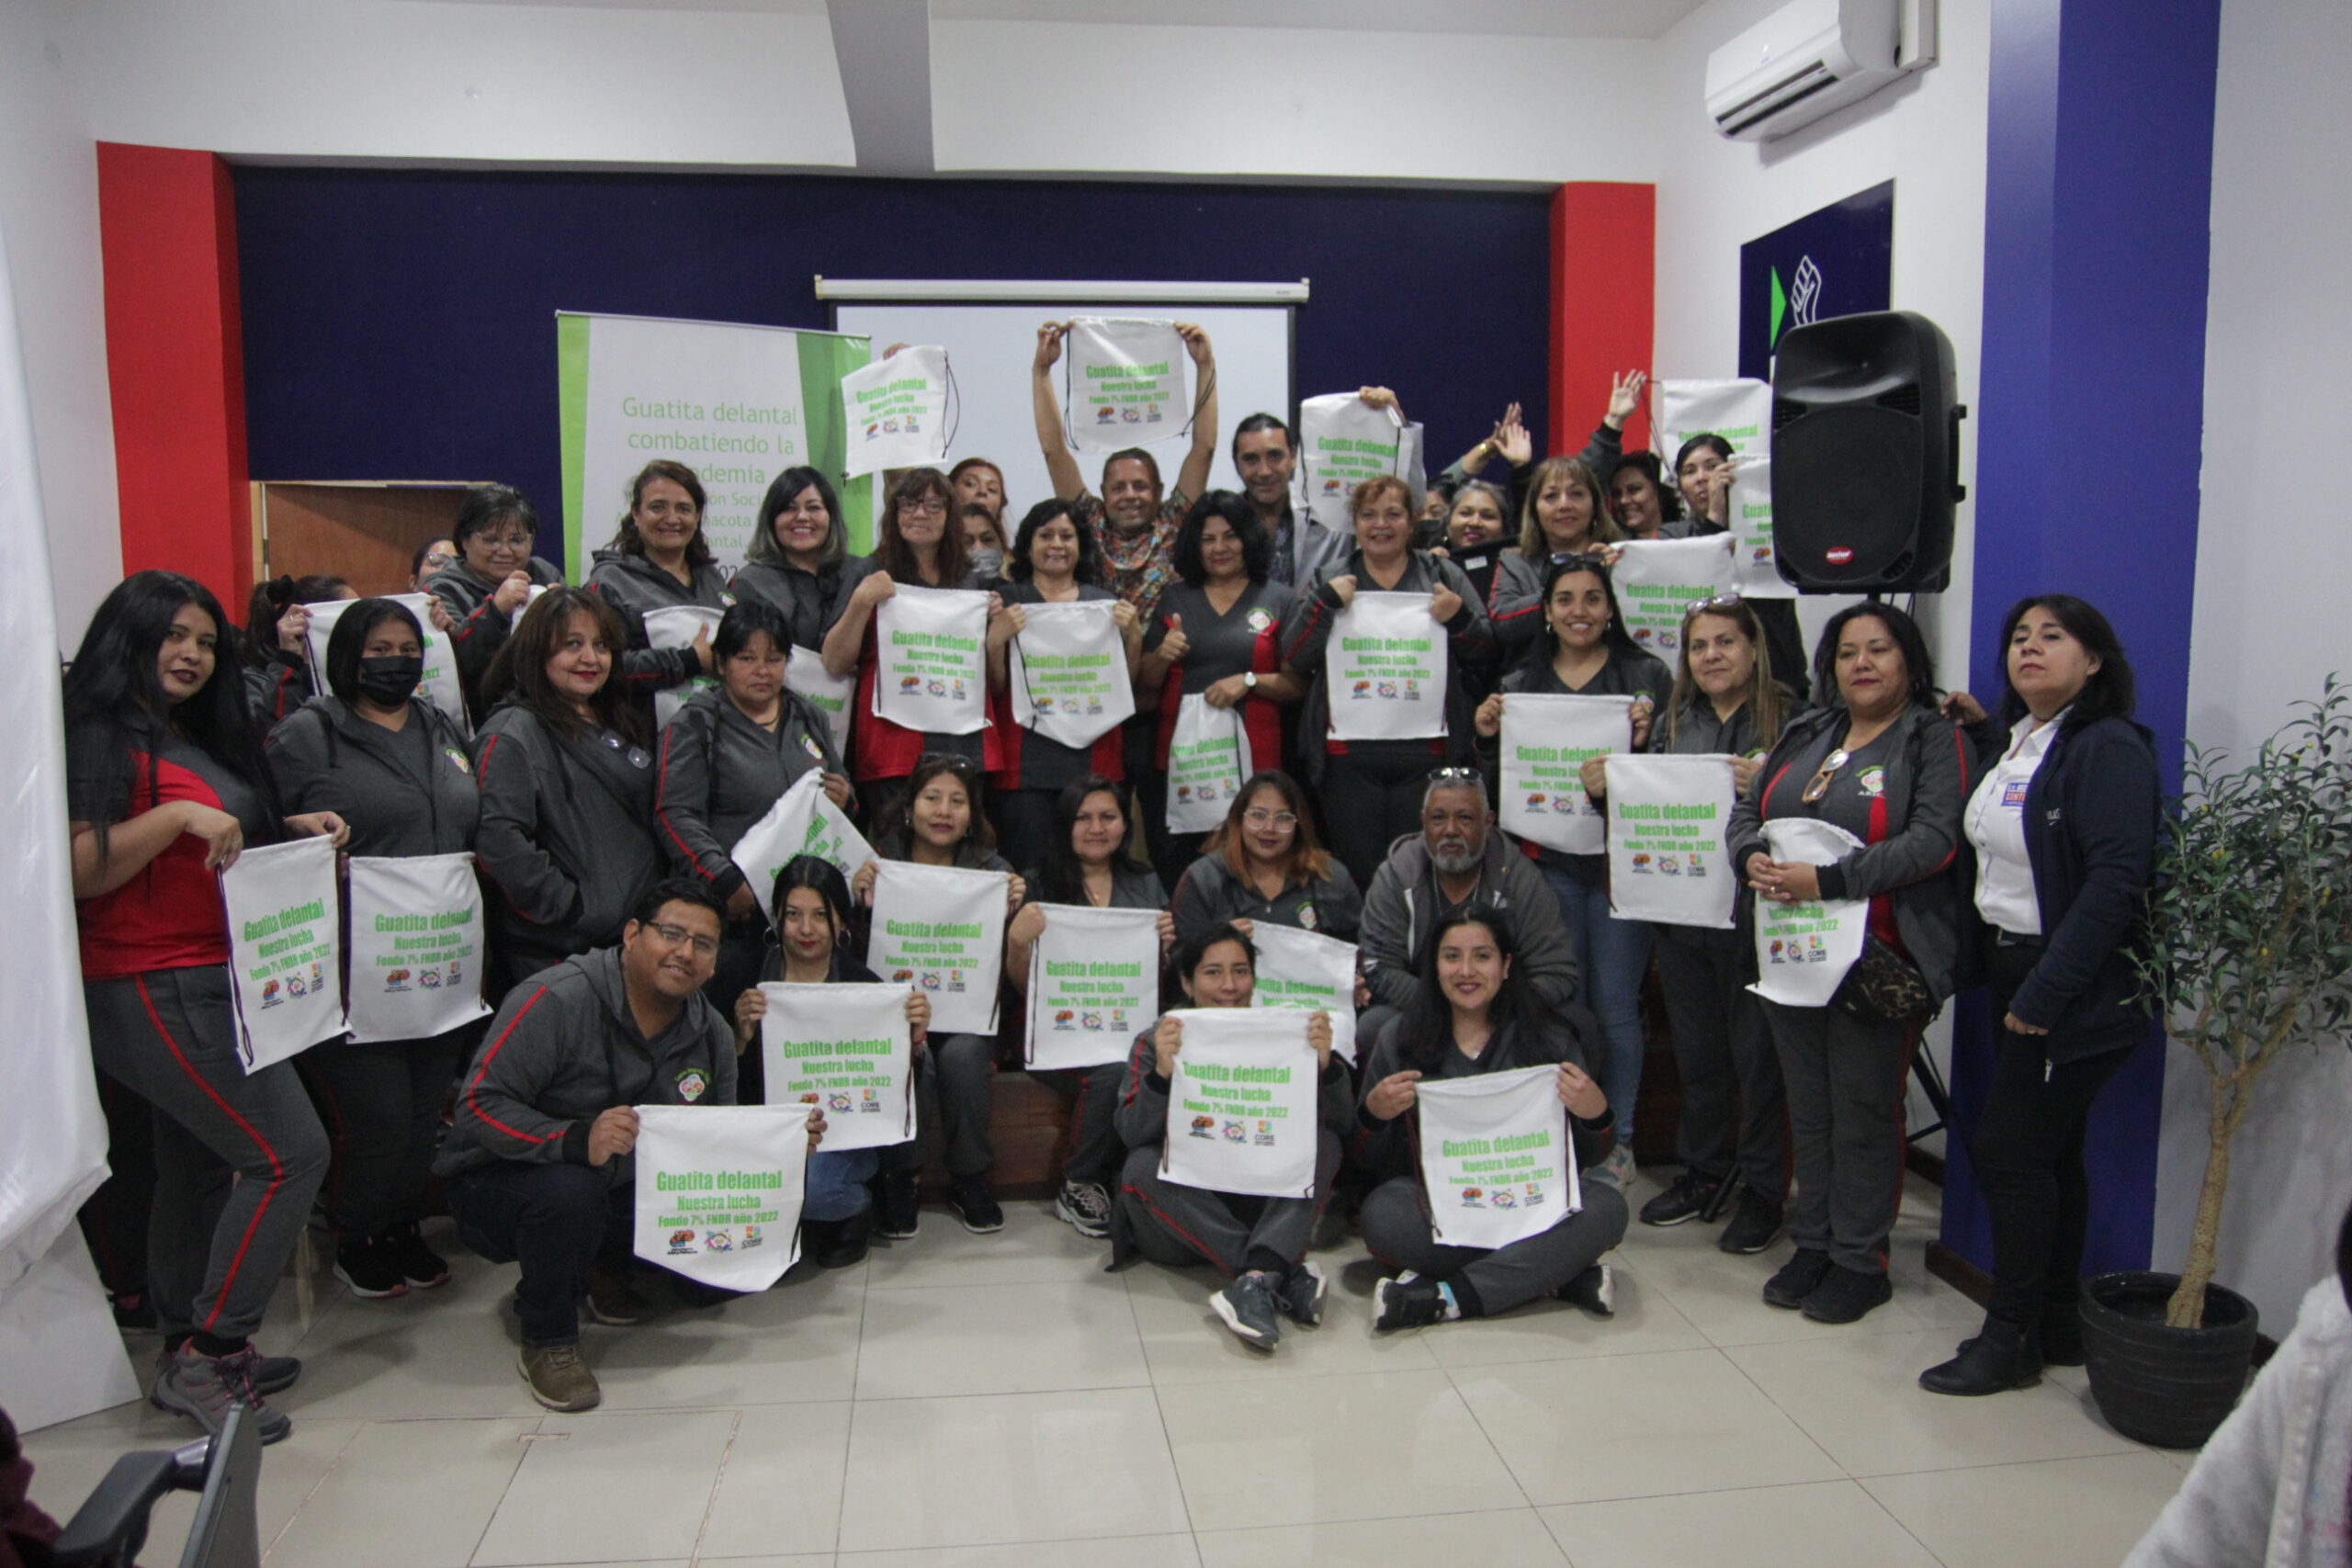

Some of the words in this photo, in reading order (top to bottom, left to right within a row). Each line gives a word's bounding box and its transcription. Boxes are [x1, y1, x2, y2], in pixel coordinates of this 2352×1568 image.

[622, 397, 705, 421] Guatita
[712, 401, 797, 426] delantal
[628, 431, 769, 454] combatiendo
[778, 435, 795, 455] la
[692, 463, 764, 484] ndemia
[892, 630, 933, 647] Guatita
[935, 634, 978, 652] delantal
[1342, 636, 1383, 651] Guatita
[1385, 637, 1431, 652] delantal
[1517, 745, 1558, 761] Guatita
[1619, 802, 1661, 819] Guatita
[1663, 802, 1716, 819] delantal
[1634, 823, 1670, 836] Nuestra
[1672, 823, 1700, 837] lucha
[244, 915, 280, 942] Guatita
[278, 897, 324, 930] delantal
[375, 914, 427, 931] Guatita
[431, 906, 472, 931] delantal
[1815, 919, 1838, 931] 2022
[887, 919, 931, 937] Guatita
[933, 923, 982, 939] delantal
[258, 937, 289, 958] Nuestra
[288, 930, 314, 948] lucha
[394, 936, 436, 951] Nuestra
[438, 931, 462, 947] lucha
[901, 941, 937, 953] Nuestra
[939, 942, 964, 953] lucha
[1046, 960, 1086, 976] Guatita
[1089, 961, 1142, 977] delantal
[1060, 980, 1095, 993] Nuestra
[1097, 980, 1125, 993] lucha
[784, 1040, 832, 1058] Guatita
[835, 1038, 892, 1055] delantal
[802, 1059, 842, 1075] Nuestra
[844, 1059, 874, 1072] lucha
[1182, 1060, 1230, 1082] Guatita
[1232, 1065, 1292, 1084] delantal
[787, 1079, 813, 1092] Fondo
[828, 1077, 851, 1089] FNDR
[869, 1076, 892, 1087] 2022
[1201, 1083, 1239, 1100] Nuestra
[1241, 1087, 1272, 1102] lucha
[1183, 1099, 1211, 1113] Fondo
[1225, 1104, 1246, 1117] FNDR
[1265, 1106, 1290, 1119] 2022
[1442, 1139, 1491, 1157] Guatita
[1494, 1129, 1551, 1154] delantal
[1462, 1157, 1504, 1173] Nuestra
[1505, 1154, 1536, 1169] lucha
[657, 1170, 714, 1191] Guatita
[717, 1169, 783, 1190] delantal
[1448, 1175, 1476, 1185] Fondo
[1489, 1173, 1513, 1185] FNDR
[1531, 1167, 1555, 1180] 2022
[677, 1195, 725, 1212] Nuestra
[727, 1193, 762, 1210] lucha
[658, 1214, 689, 1228] Fondo
[707, 1213, 732, 1225] FNDR
[754, 1210, 779, 1224] 2022
